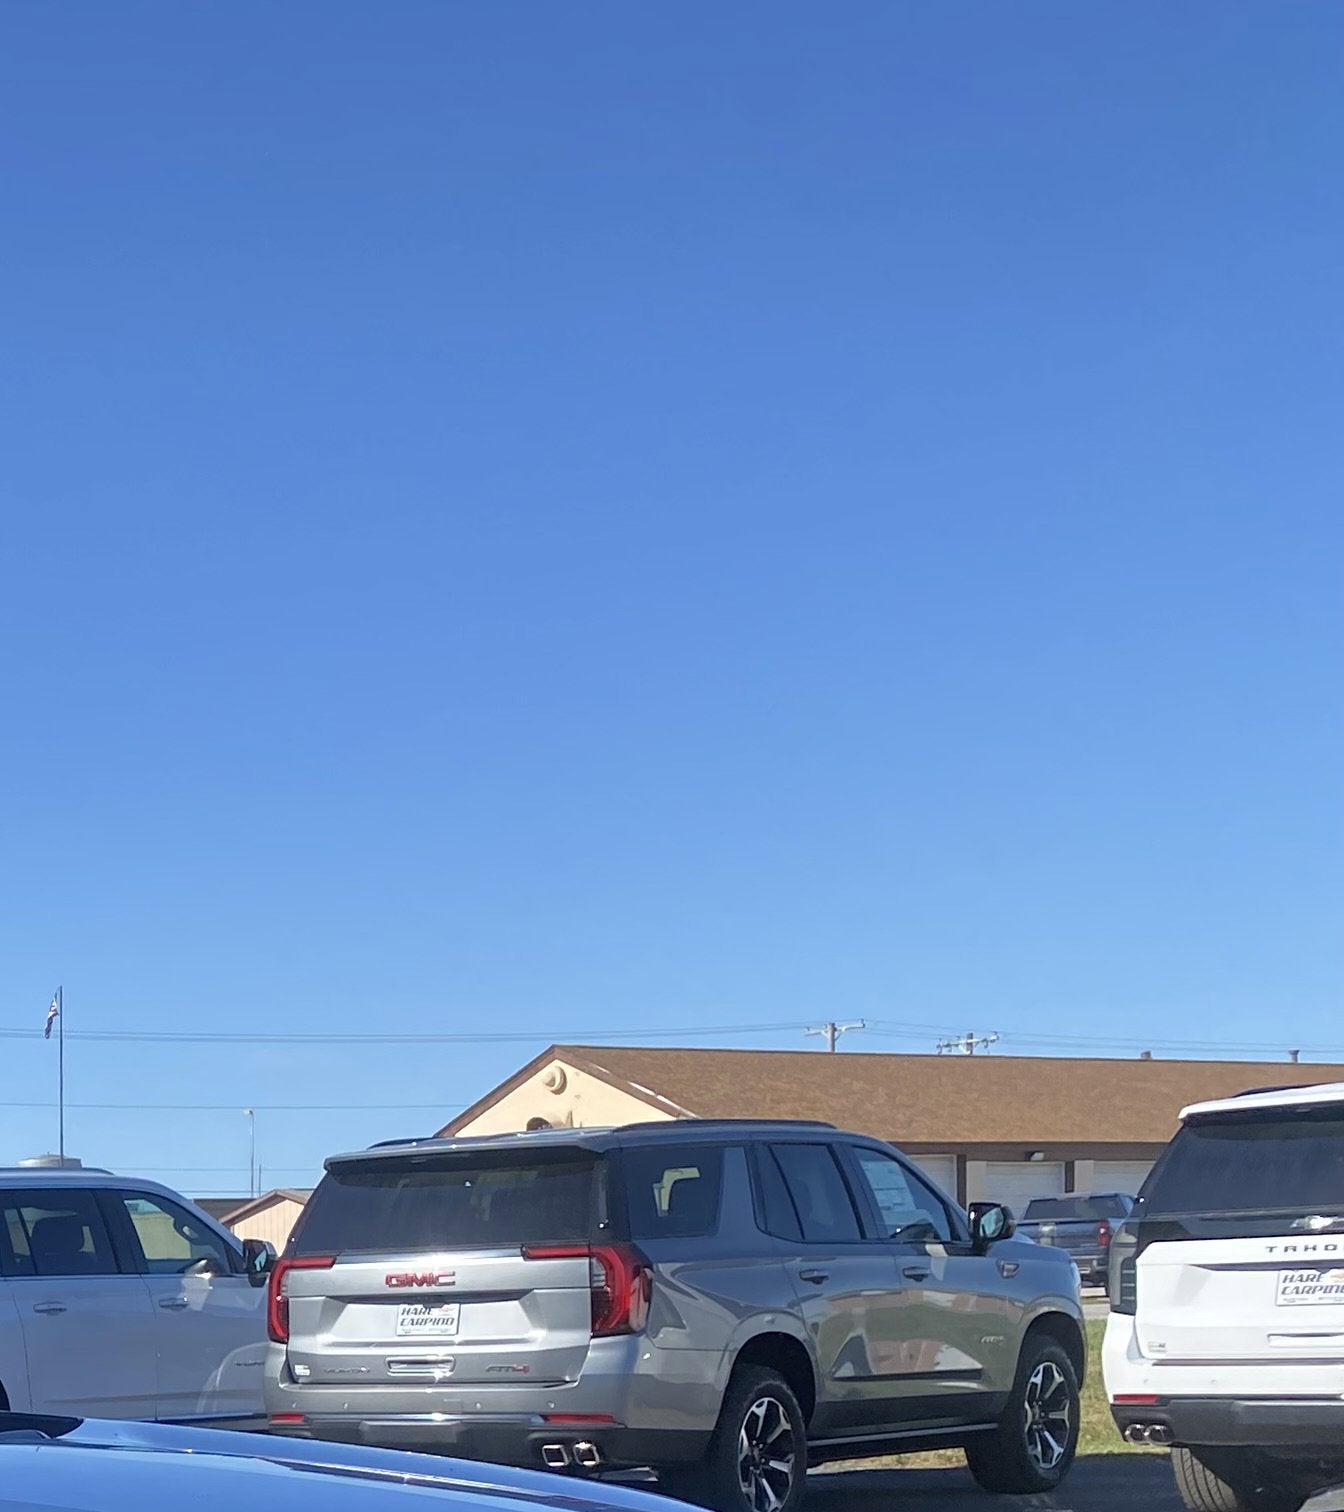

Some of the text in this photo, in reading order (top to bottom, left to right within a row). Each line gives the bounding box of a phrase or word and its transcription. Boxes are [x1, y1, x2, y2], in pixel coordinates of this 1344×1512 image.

[1265, 1244, 1344, 1253] TAHO
[385, 1271, 456, 1288] GMC
[1282, 1273, 1323, 1283] HARE
[1281, 1285, 1344, 1295] CARPIN
[400, 1317, 455, 1327] CARPINO
